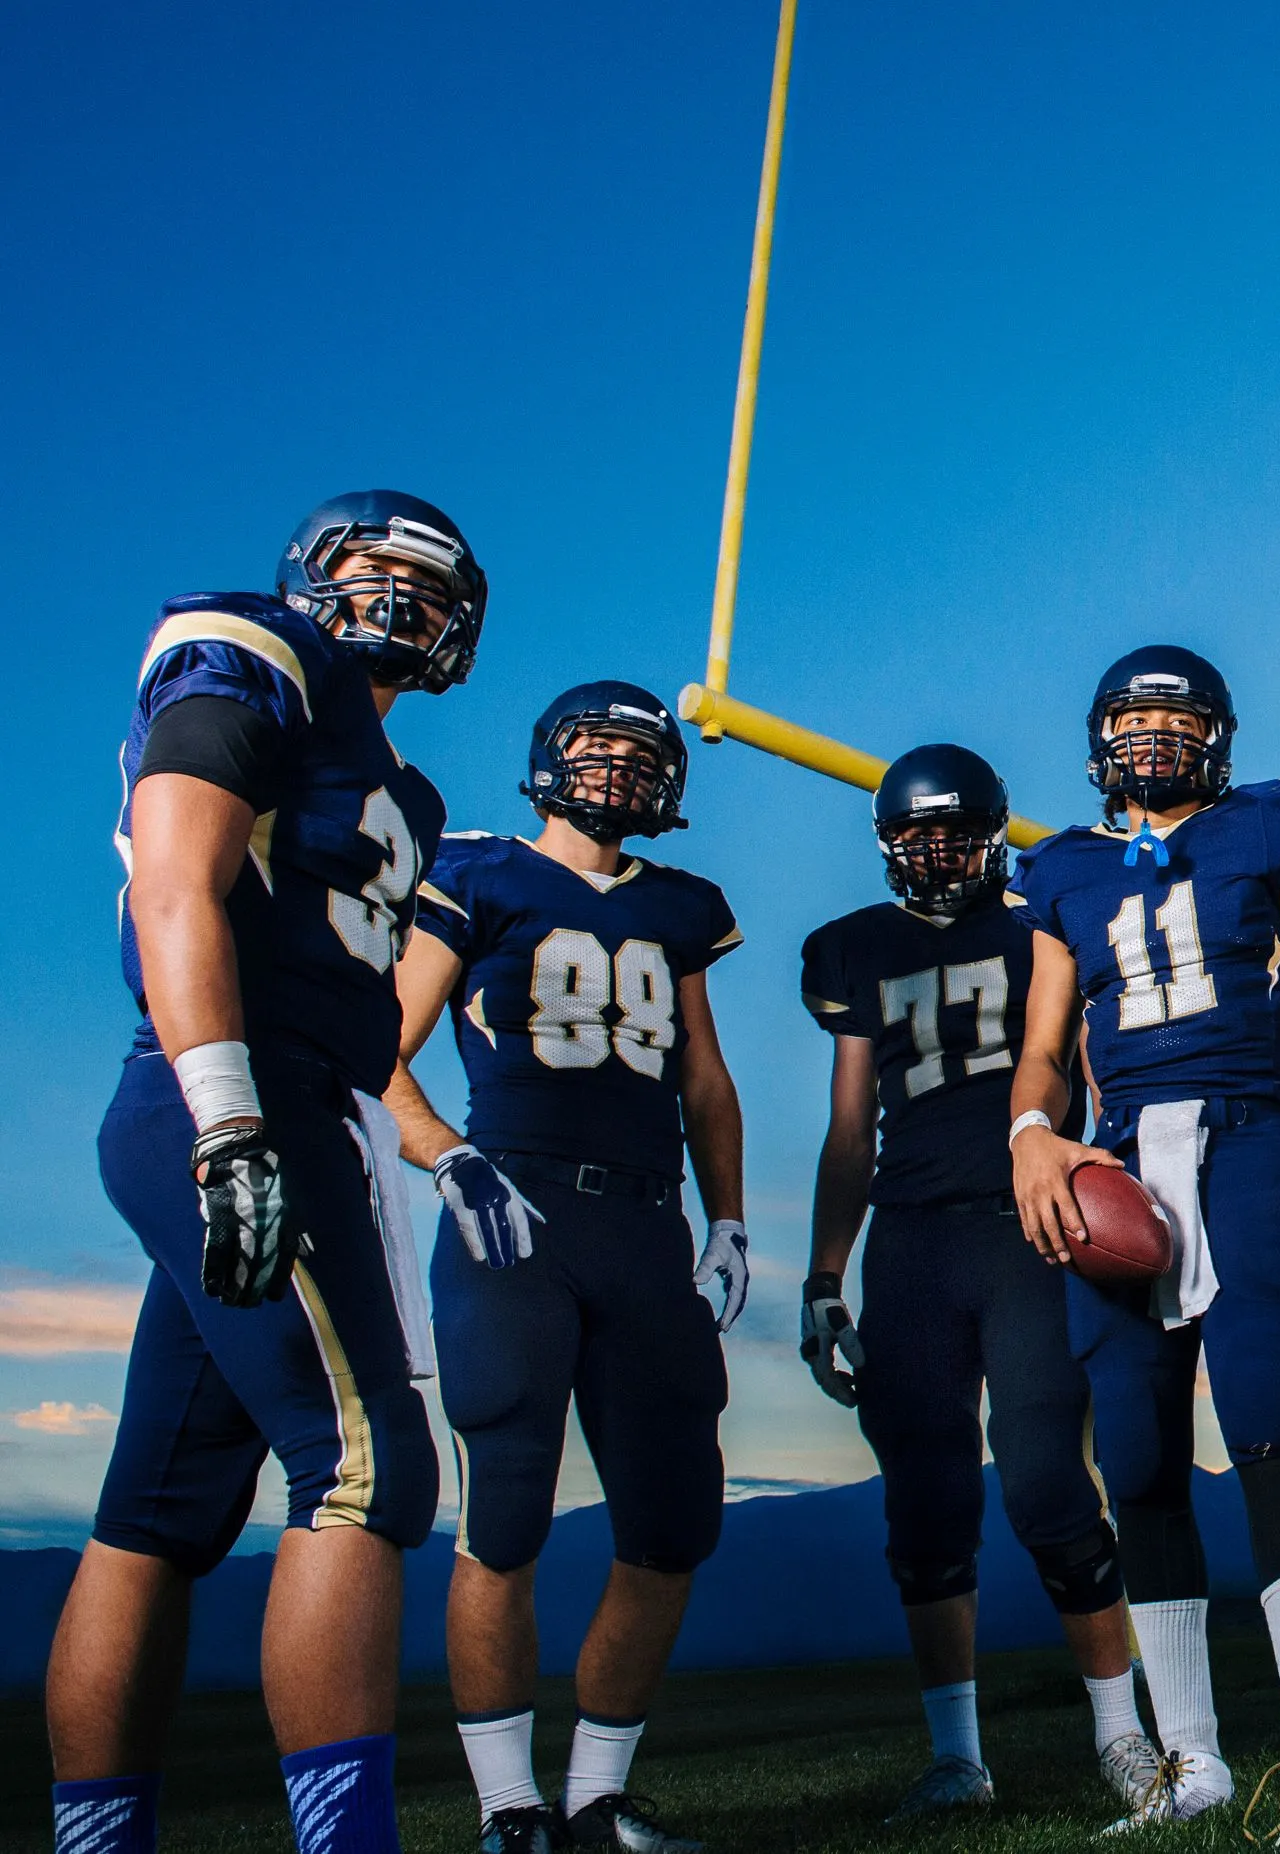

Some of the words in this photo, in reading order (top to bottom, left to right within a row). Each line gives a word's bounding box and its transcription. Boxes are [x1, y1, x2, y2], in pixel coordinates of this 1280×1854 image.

[528, 928, 676, 1081] 88
[879, 956, 1013, 1099] 77
[1106, 880, 1218, 1031] 11
